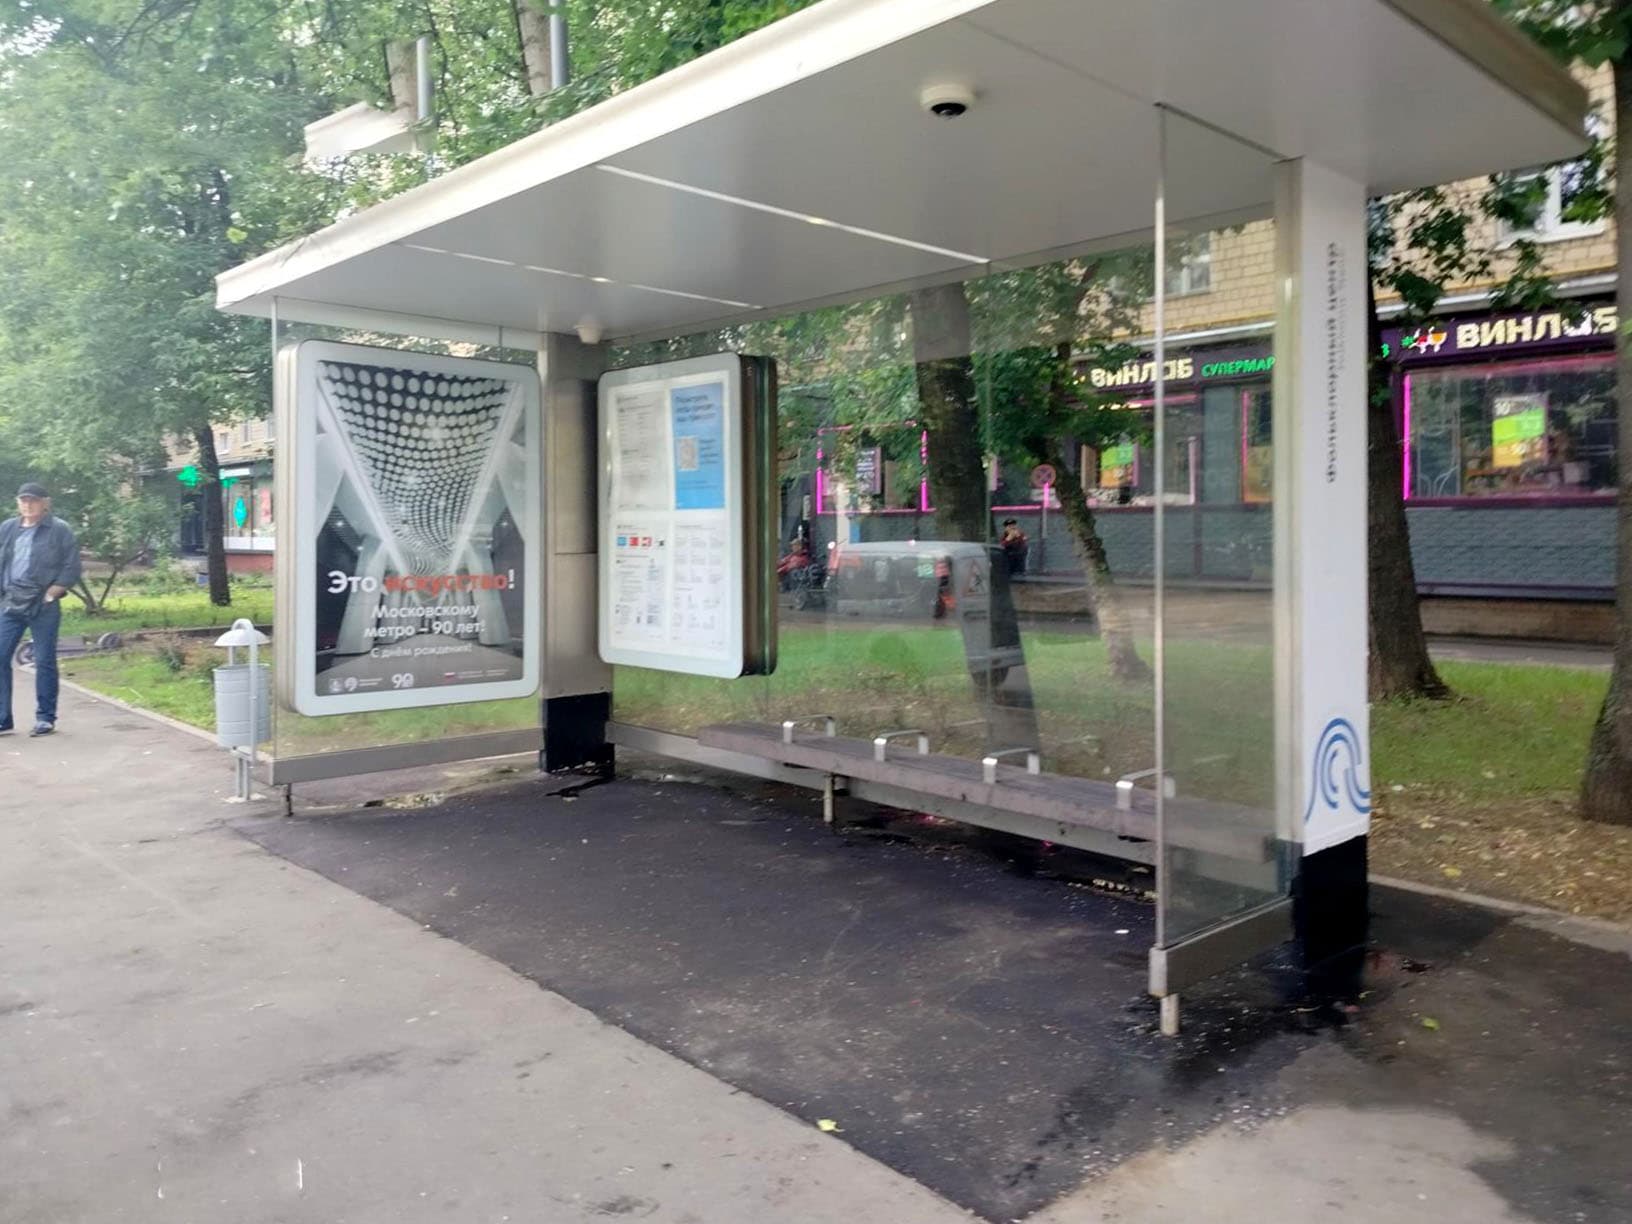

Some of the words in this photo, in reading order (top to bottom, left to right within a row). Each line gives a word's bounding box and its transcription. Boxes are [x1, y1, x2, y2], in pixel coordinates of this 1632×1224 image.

[327, 570, 377, 593] Это
[371, 604, 480, 618] Московскому
[363, 625, 416, 640] метро
[432, 621, 453, 634] 90
[455, 620, 487, 634] лет!
